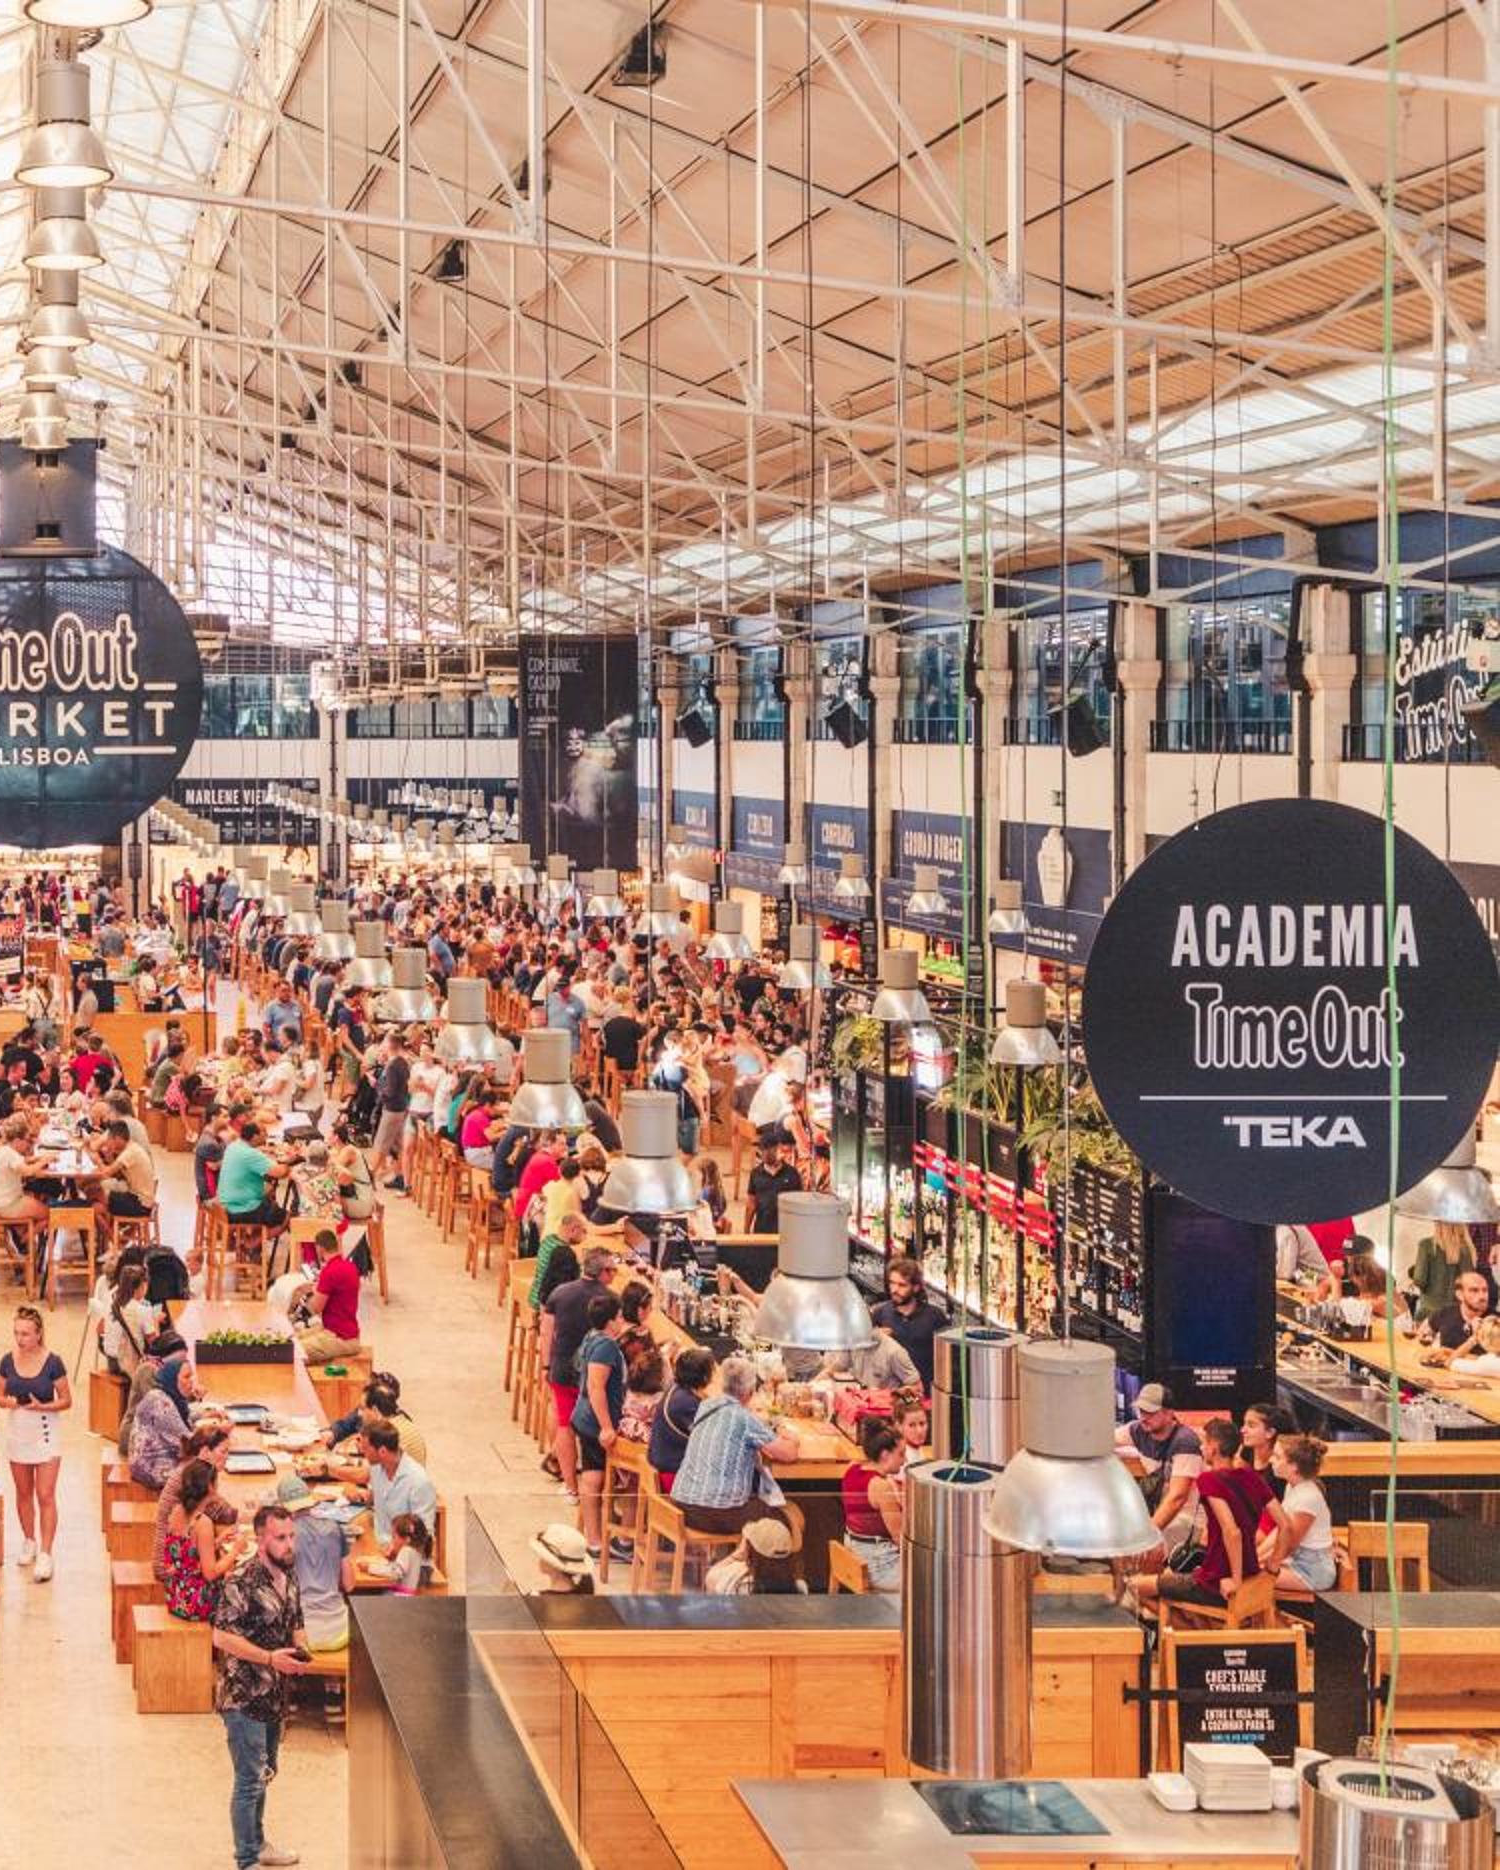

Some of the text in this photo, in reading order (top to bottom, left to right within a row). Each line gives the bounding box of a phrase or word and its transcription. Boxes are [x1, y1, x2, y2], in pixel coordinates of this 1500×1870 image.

[52, 612, 138, 691] Out
[1396, 618, 1472, 686] Estúdi
[185, 789, 240, 804] MARLENE
[1171, 904, 1419, 967] ACADEMIA
[1185, 982, 1405, 1069] Time Out
[1223, 1116, 1367, 1147] TEKA
